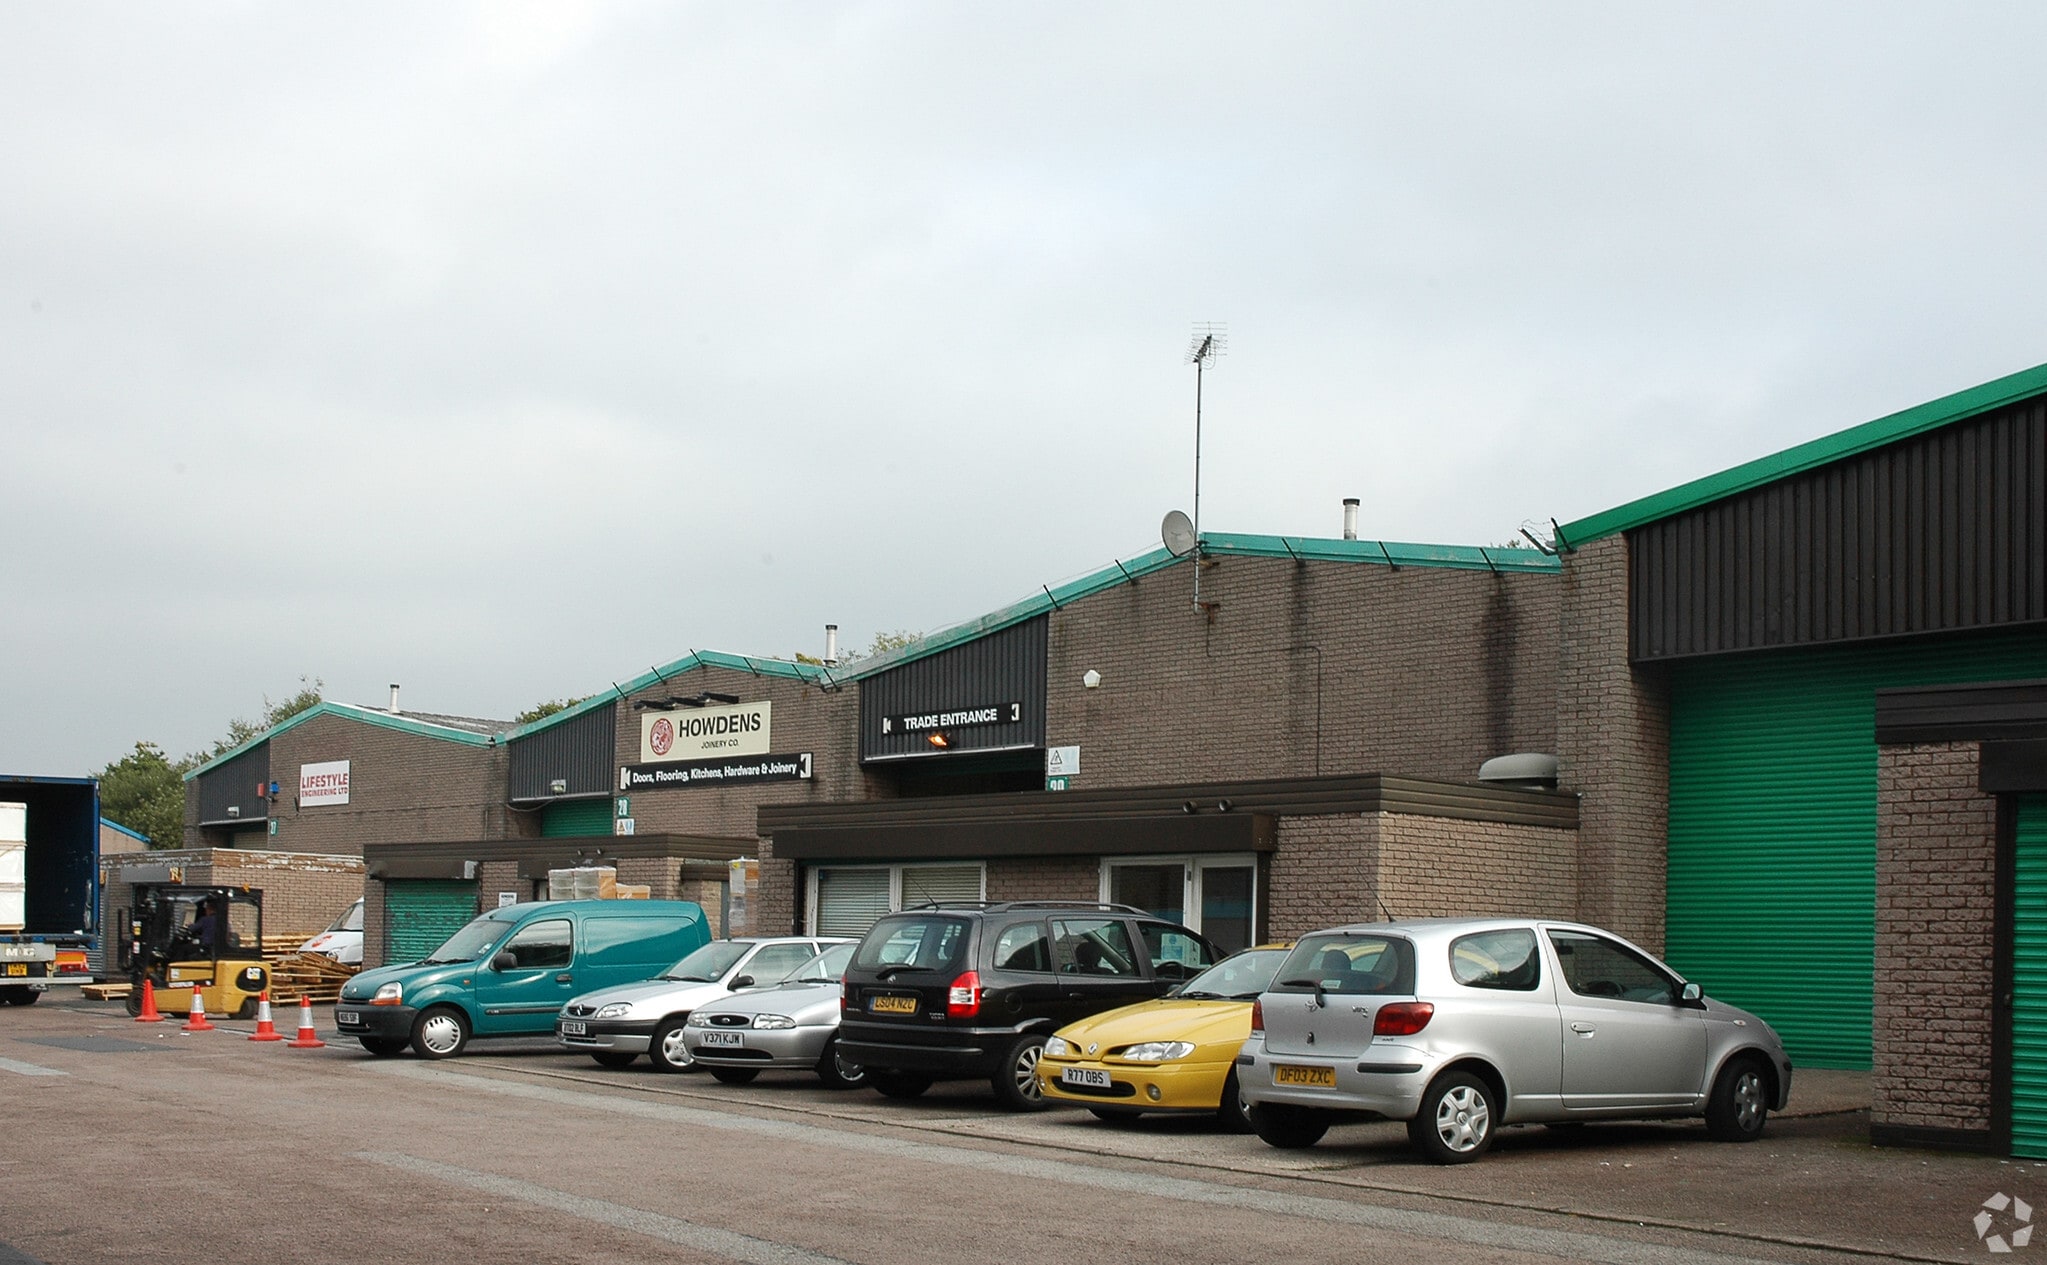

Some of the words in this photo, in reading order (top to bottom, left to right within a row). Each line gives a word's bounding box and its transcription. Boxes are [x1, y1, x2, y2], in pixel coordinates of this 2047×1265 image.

[679, 712, 761, 738] HOWDENS
[904, 714, 938, 730] TRADE
[940, 708, 997, 727] ENTRANCE
[701, 739, 727, 749] JOINERY
[728, 739, 739, 747] CO.
[632, 772, 655, 783] Doors,
[656, 769, 689, 782] Flooring,
[690, 767, 723, 780] Kitchens,
[724, 764, 760, 777] Hardware
[761, 763, 768, 774] &
[768, 762, 797, 775] Joinery
[301, 773, 348, 788] LIFESTYLE
[301, 788, 336, 797] ENGINEERING
[338, 786, 348, 795] LTD
[874, 996, 895, 1008] LS04
[896, 998, 914, 1010] NZC
[704, 1033, 721, 1043] V371
[1067, 1069, 1083, 1081] R77
[1280, 1068, 1307, 1082] DF03
[1309, 1068, 1331, 1084] ZXC
